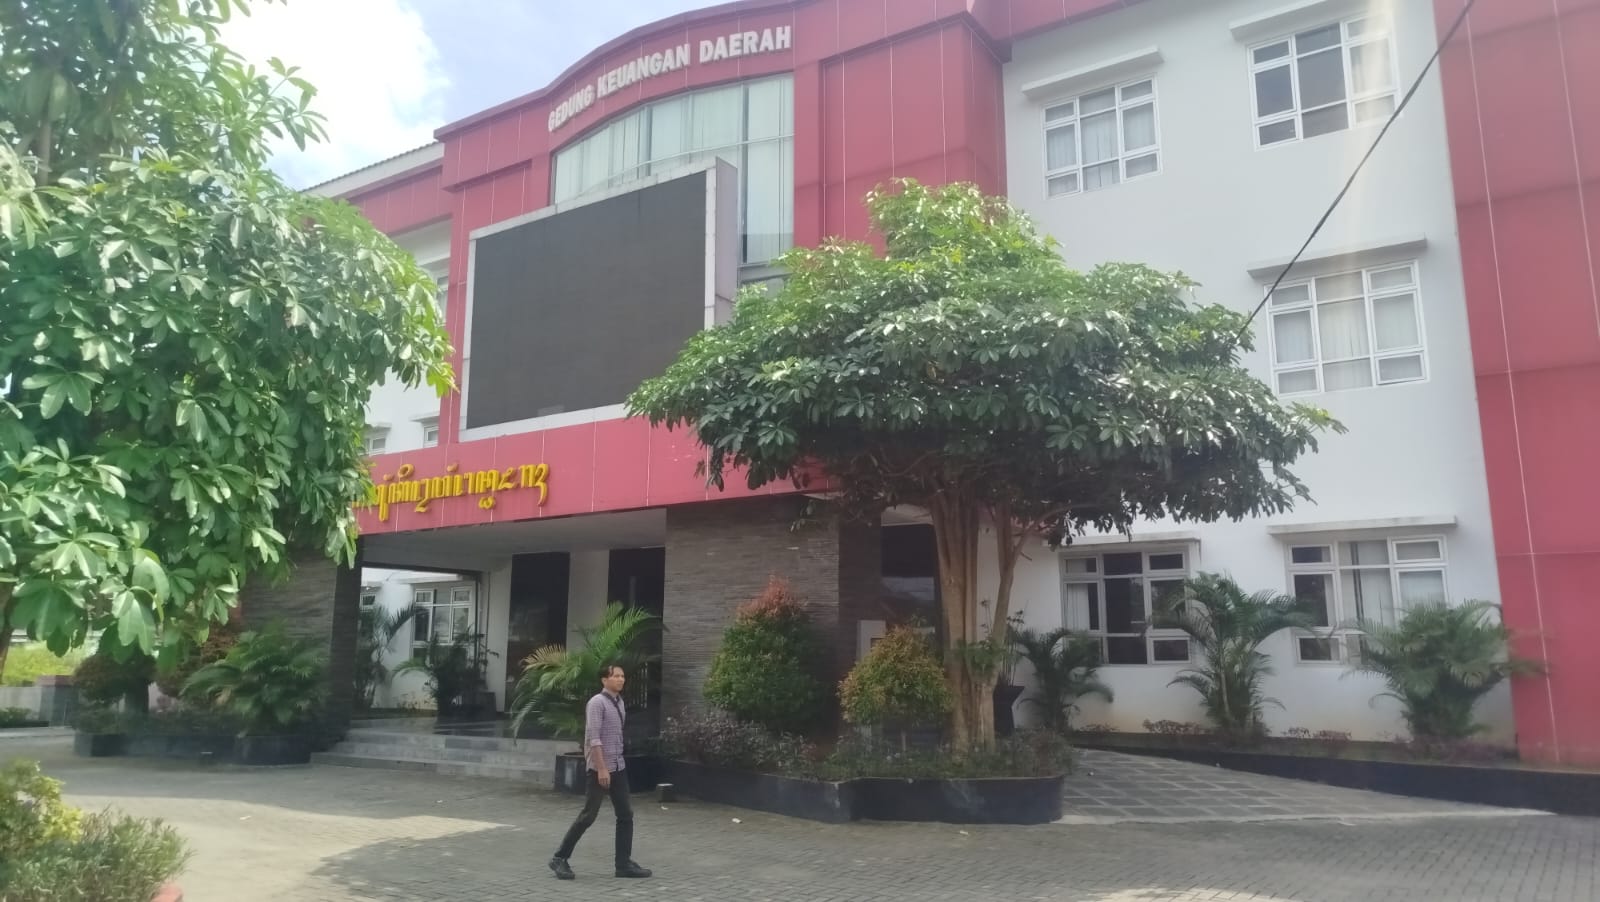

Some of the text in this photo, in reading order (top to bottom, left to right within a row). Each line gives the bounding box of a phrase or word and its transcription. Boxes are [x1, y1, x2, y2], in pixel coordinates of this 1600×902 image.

[548, 25, 792, 132] GEDUNG KEUANGAN DAERAH
